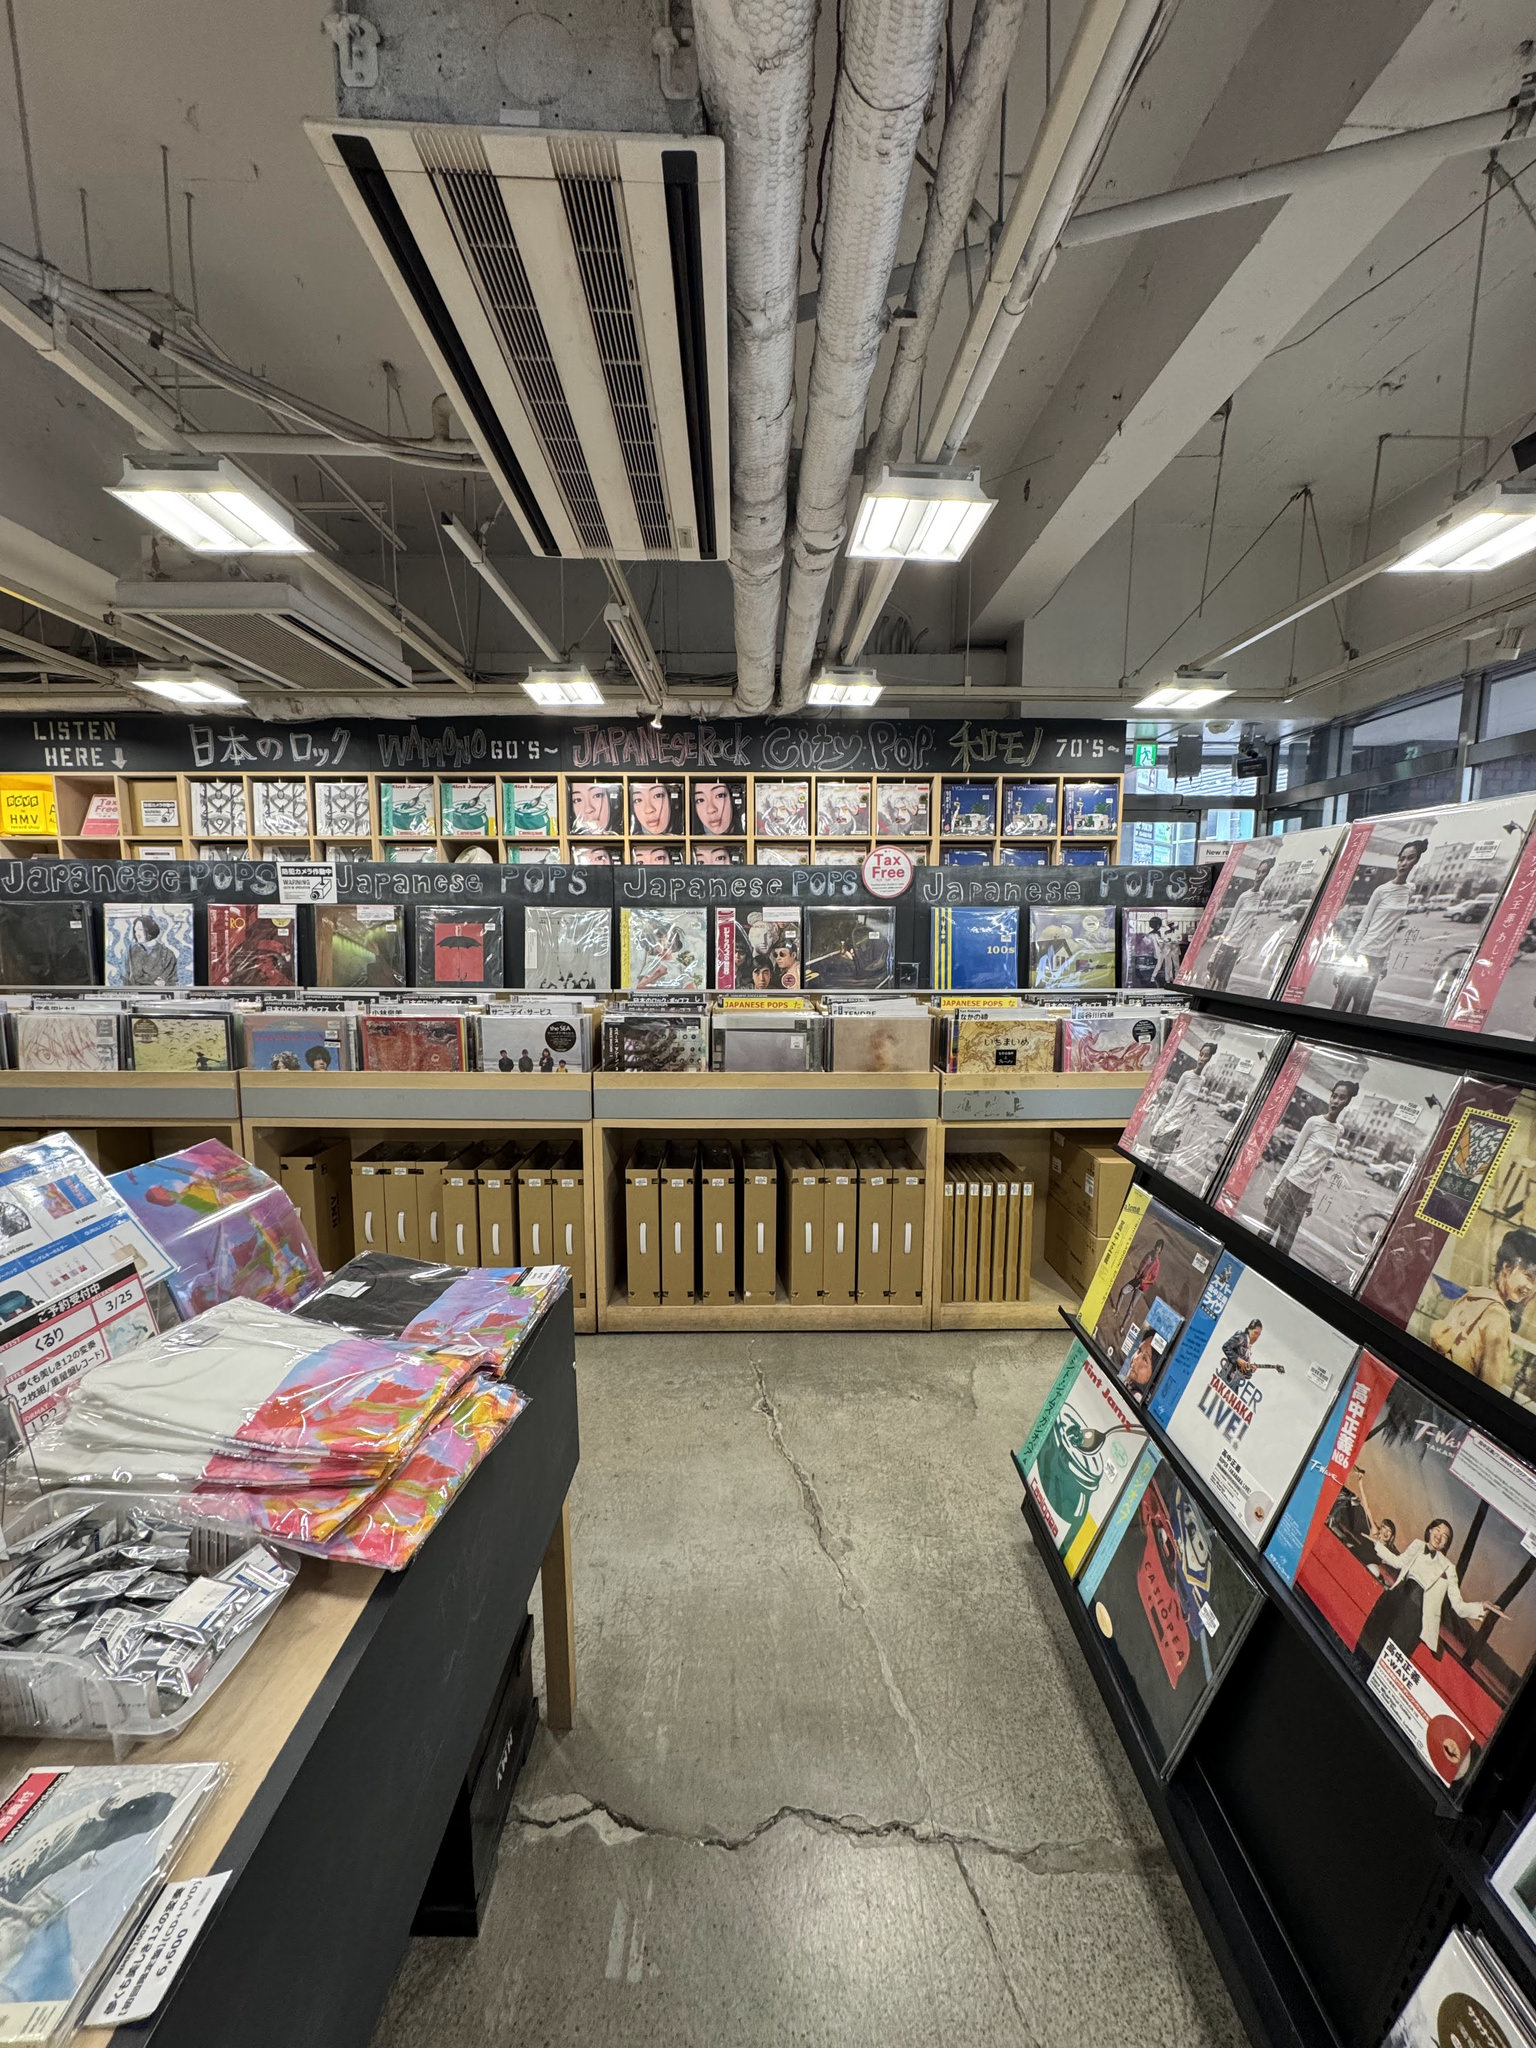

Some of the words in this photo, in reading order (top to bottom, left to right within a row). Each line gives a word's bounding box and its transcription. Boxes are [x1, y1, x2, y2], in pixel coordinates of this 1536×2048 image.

[33, 720, 117, 741] LISTEN
[187, 723, 351, 767] 日本のロック
[44, 747, 104, 767] HERE
[10, 814, 39, 825] HMV
[872, 866, 905, 879] Free
[874, 853, 902, 866] Tax
[1, 861, 181, 896] Japanese
[337, 864, 483, 899] Japanese
[501, 865, 588, 896] POPS
[624, 867, 783, 902] Japanese
[792, 870, 858, 898] POPS
[923, 872, 1081, 904] Japanese
[986, 946, 1015, 954] 100s
[724, 1001, 766, 1009] JAPANESE
[767, 1001, 789, 1009] POPS
[984, 1037, 1030, 1047] いちまいめ
[37, 1283, 101, 1324] ご予約受付中
[105, 1290, 134, 1312] 3/25
[34, 1327, 65, 1352] くるり
[23, 1403, 51, 1422] ORMAT
[1102, 1387, 1133, 1433] Jams
[1209, 1373, 1254, 1425] TAKANAKA
[1198, 1385, 1249, 1451] LIVE!
[1336, 1381, 1371, 1453] 高中正義
[1144, 1560, 1186, 1663] CASIOPEA
[1383, 1650, 1414, 1690] T-WAVE
[1386, 1641, 1422, 1686] 高中正義
[155, 1928, 189, 1978] 6,600
